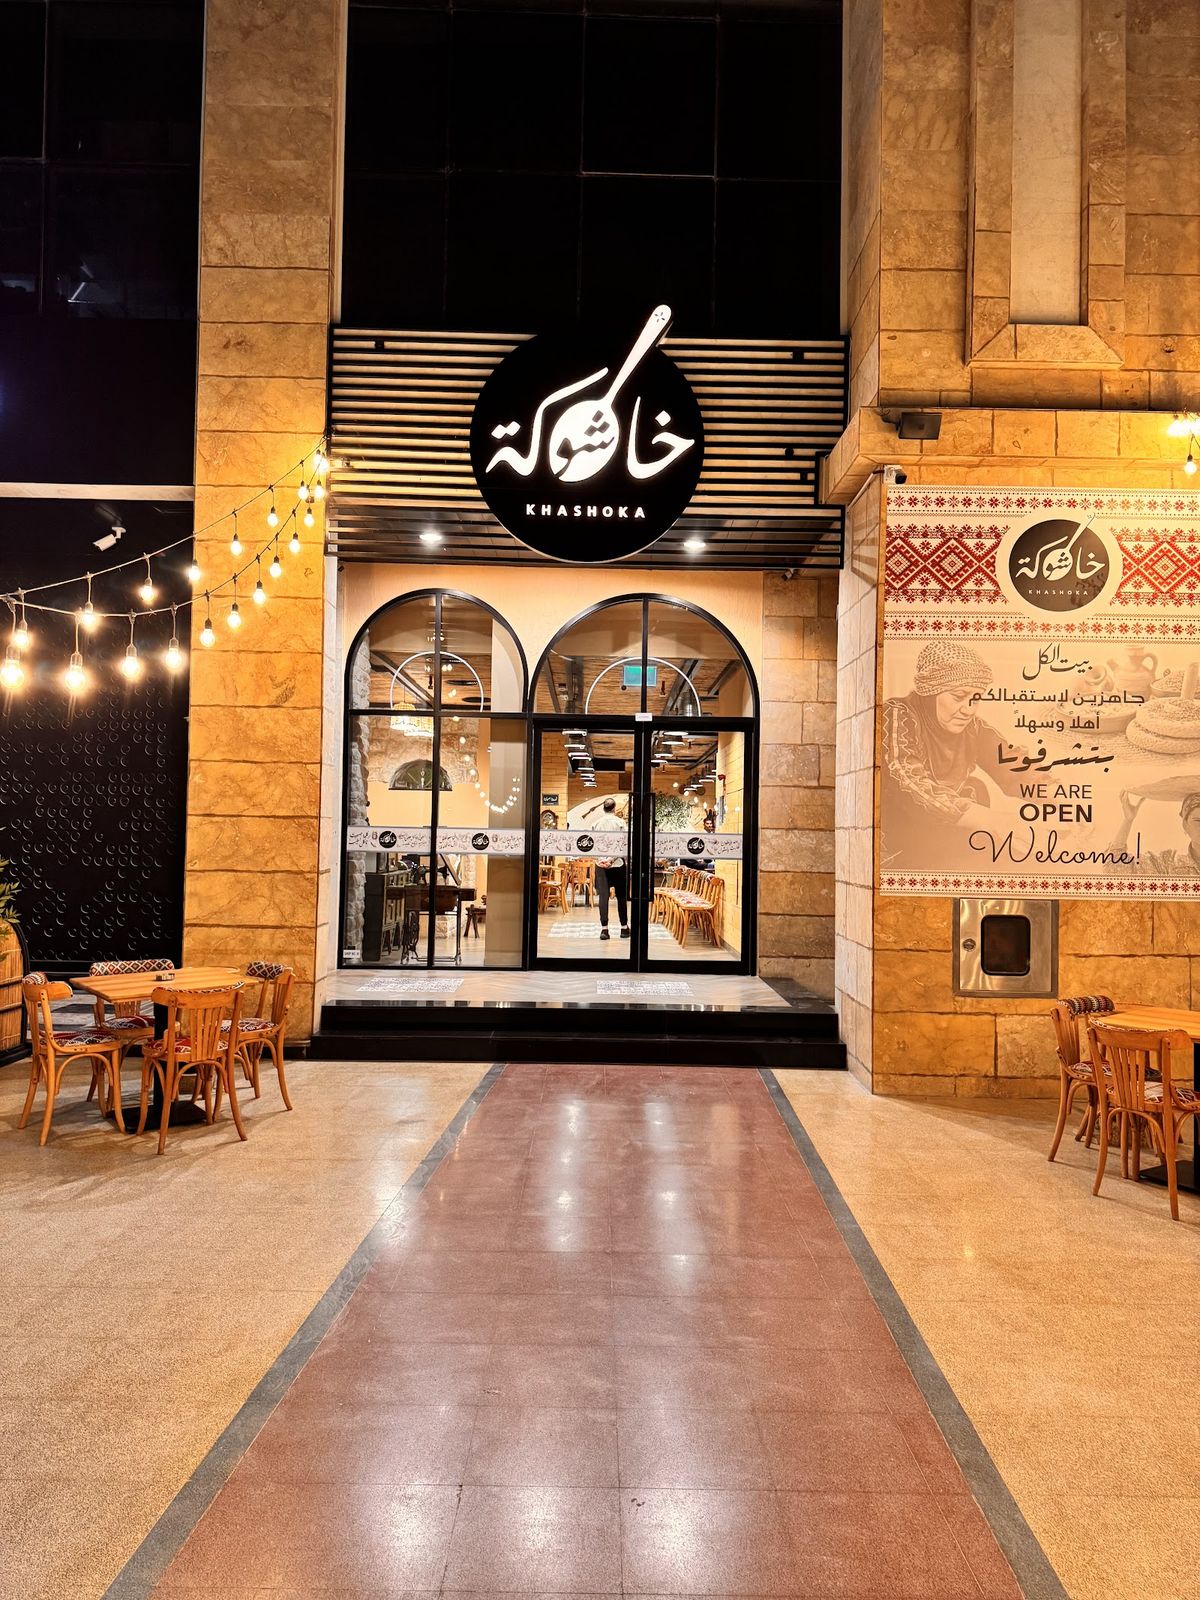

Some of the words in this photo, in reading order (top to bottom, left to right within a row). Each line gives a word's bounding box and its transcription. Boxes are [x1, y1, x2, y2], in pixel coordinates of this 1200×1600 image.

[485, 366, 696, 483] خاشوكة
[526, 503, 646, 519] KHASHOKA
[1015, 535, 1106, 581] خاشوكة
[1022, 643, 1061, 681] الكل
[1050, 658, 1093, 674] بيت
[1072, 689, 1146, 707] جاهزين
[997, 738, 1115, 773] بتشرفونا
[1019, 783, 1048, 799] WE
[1053, 784, 1093, 800] ARE
[1019, 803, 1093, 823] OPEN
[968, 825, 1142, 866] Welcome!
